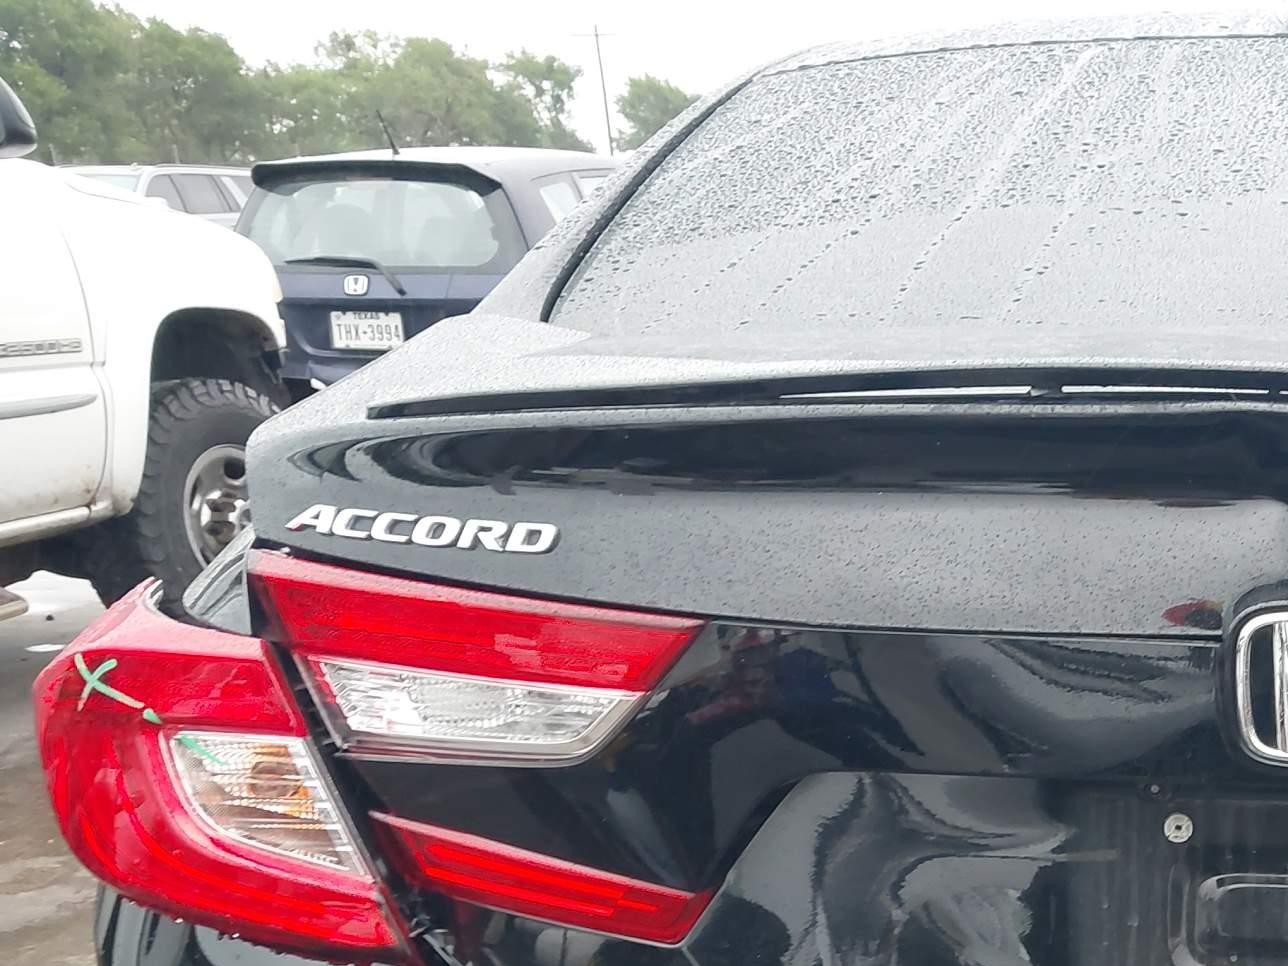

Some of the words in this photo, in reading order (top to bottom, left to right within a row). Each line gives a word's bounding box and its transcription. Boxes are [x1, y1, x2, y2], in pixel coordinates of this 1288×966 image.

[352, 311, 381, 321] TEXAS
[336, 323, 401, 342] THX-3994
[284, 503, 561, 554] ACCORD
